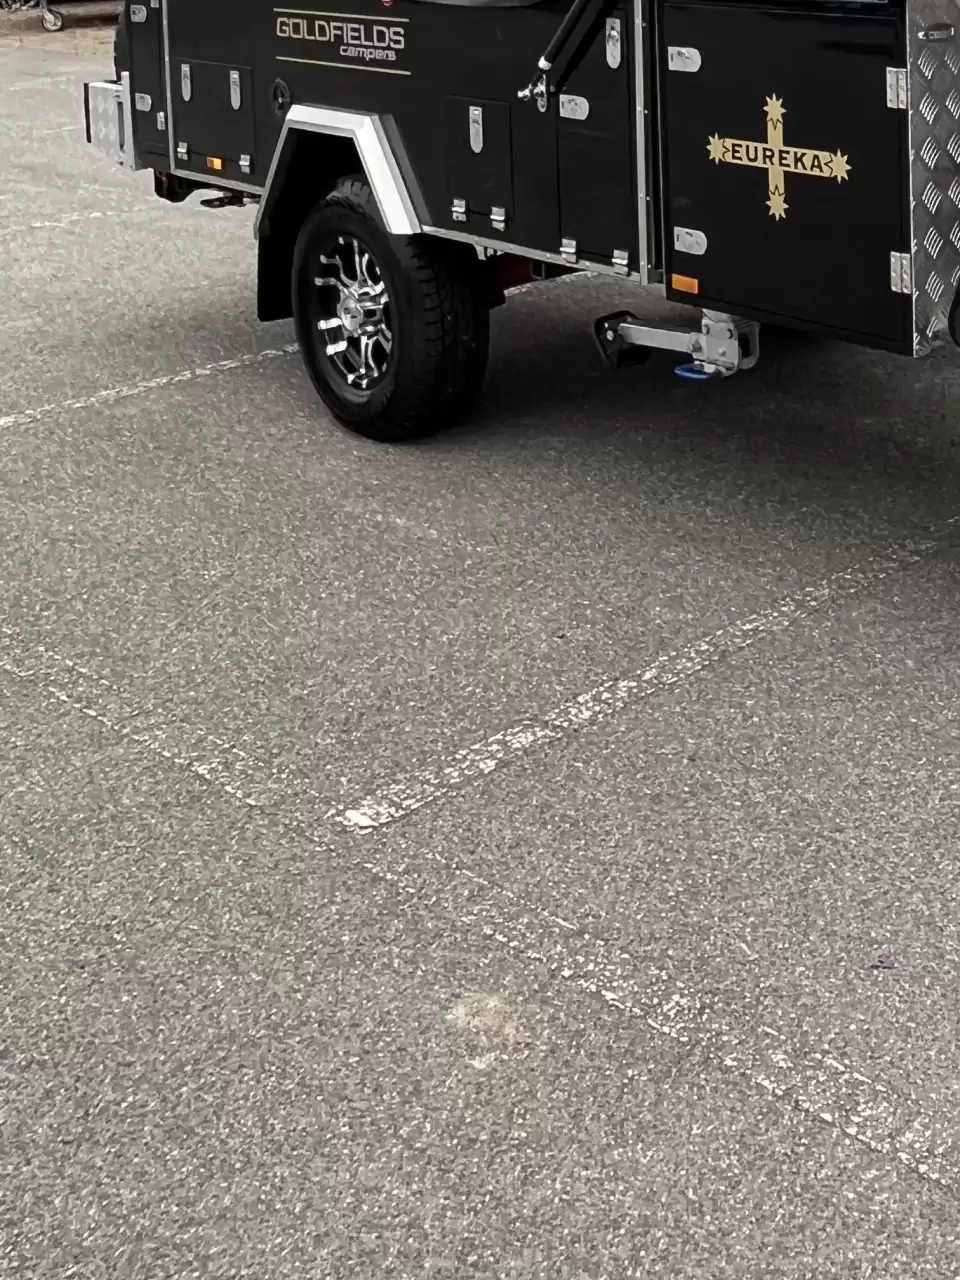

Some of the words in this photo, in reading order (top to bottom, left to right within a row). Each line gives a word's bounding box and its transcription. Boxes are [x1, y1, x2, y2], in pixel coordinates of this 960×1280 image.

[276, 17, 405, 49] GOLDFIELDS
[340, 45, 396, 61] campers
[731, 143, 824, 173] EUREKA
